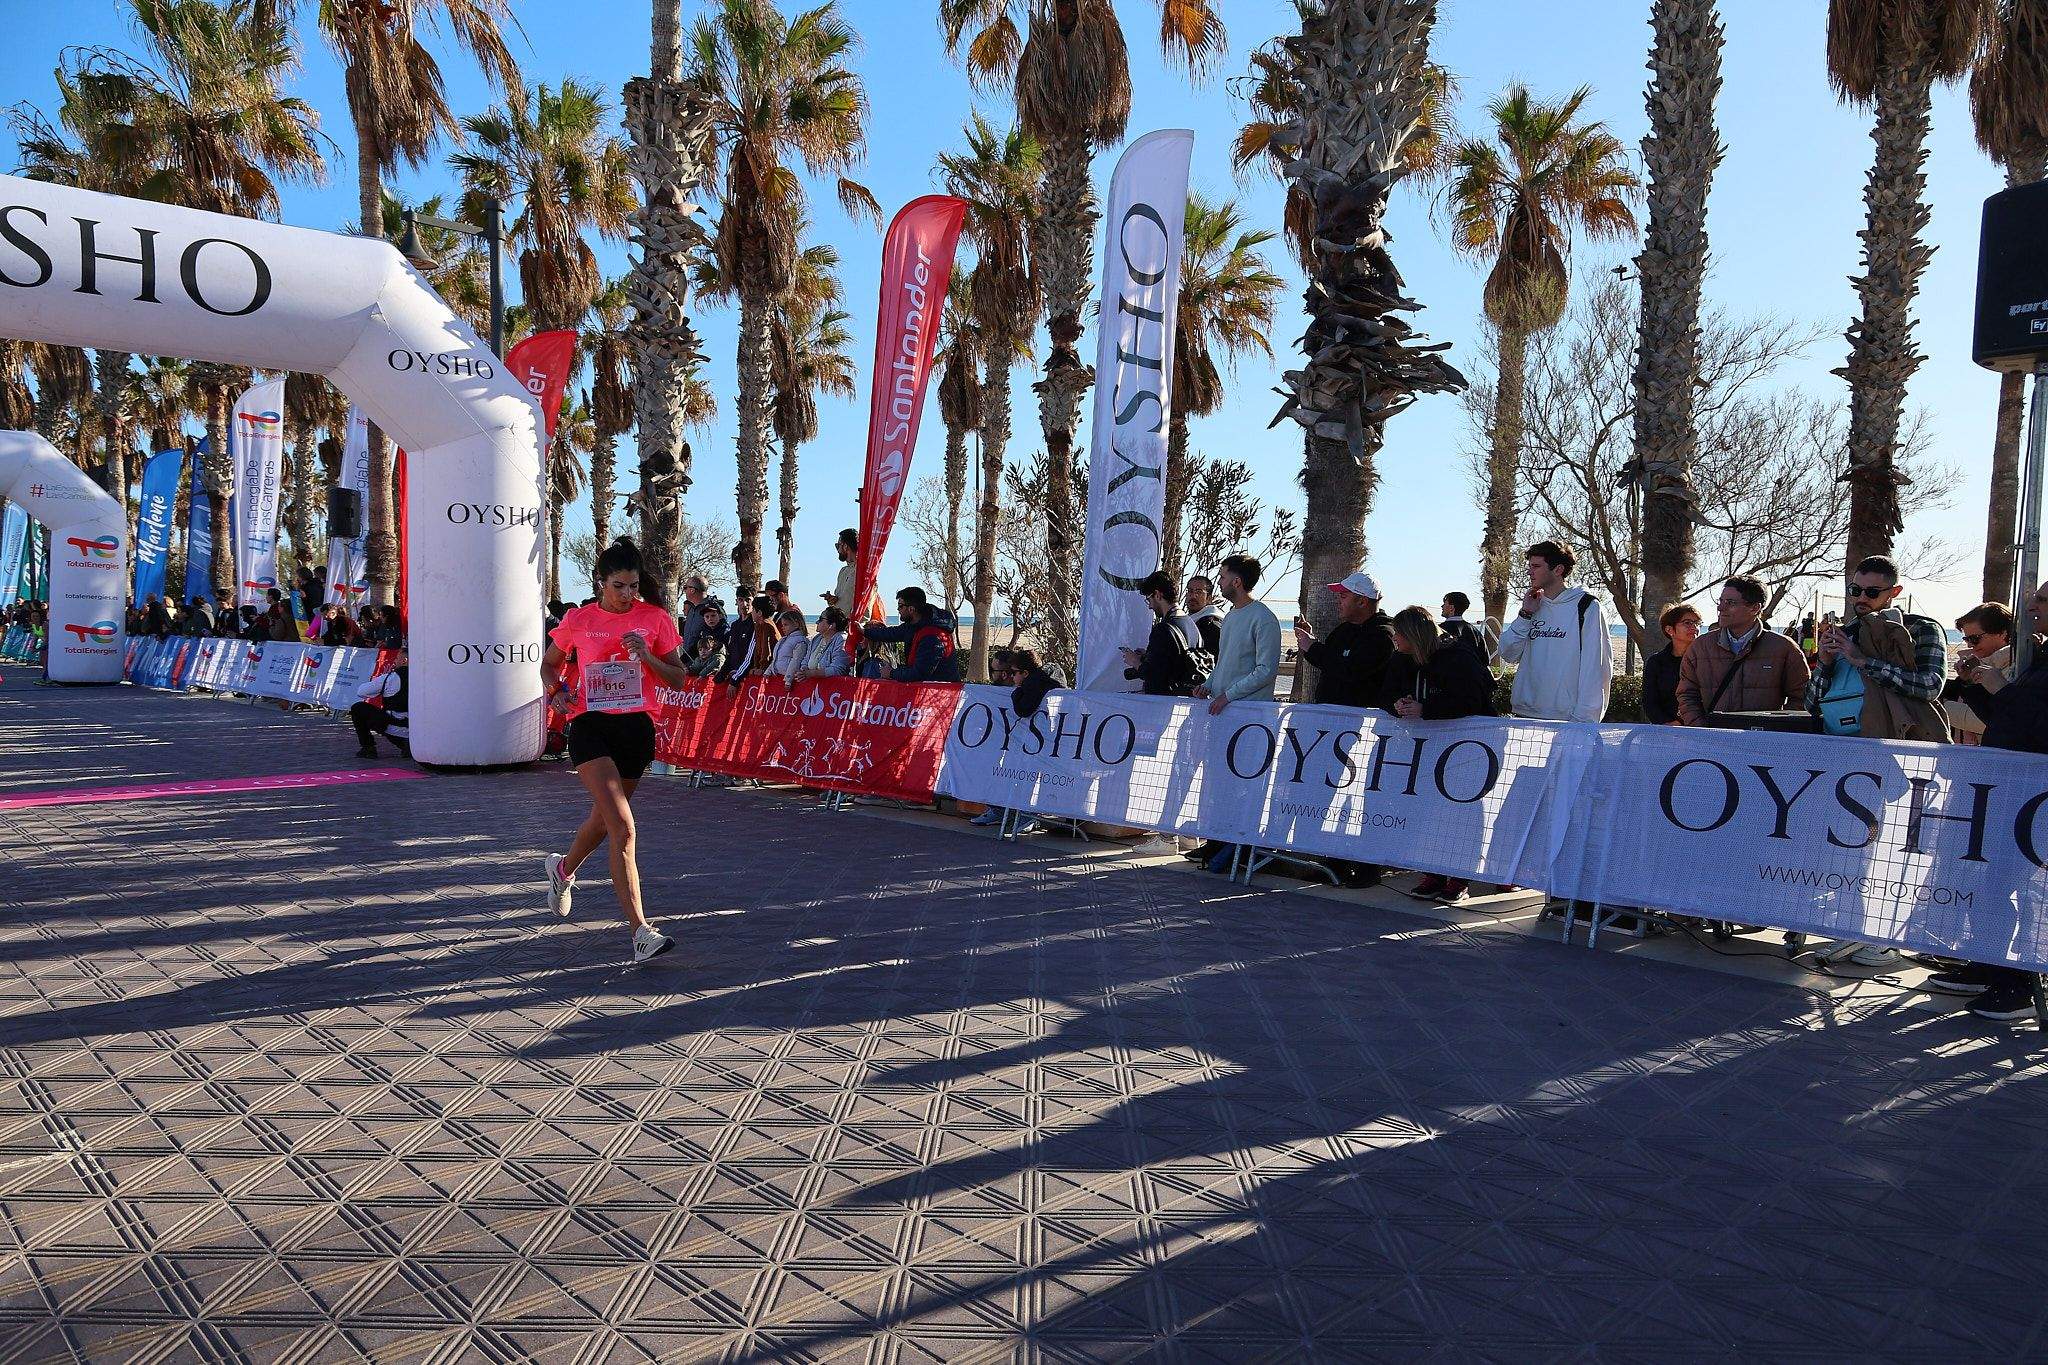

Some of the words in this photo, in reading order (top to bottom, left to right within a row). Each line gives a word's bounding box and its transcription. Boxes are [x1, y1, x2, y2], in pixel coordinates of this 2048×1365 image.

[0, 205, 272, 317] SHO
[883, 243, 932, 444] Santander
[388, 349, 494, 380] OYSHO
[527, 366, 548, 400] er
[1099, 203, 1169, 592] OYSHO
[260, 460, 276, 533] LasCarreras
[138, 495, 168, 565] Marlene
[447, 502, 540, 528] OYSHO
[66, 560, 119, 571] TotalEnergies
[64, 647, 118, 656] TotalEnergies
[585, 631, 610, 639] OYSHO
[447, 642, 540, 665] OYSHO
[654, 685, 708, 710] ntander
[744, 685, 801, 719] Sports
[825, 692, 932, 730] Santander
[957, 702, 1137, 765] OYSHO
[992, 766, 1075, 787] WWW.OYSHO.COM
[1226, 723, 1500, 804] OYSHO
[1280, 802, 1407, 830] WWW.OYSHO.COM
[1759, 864, 1974, 908] WWW.OYSHO.COM
